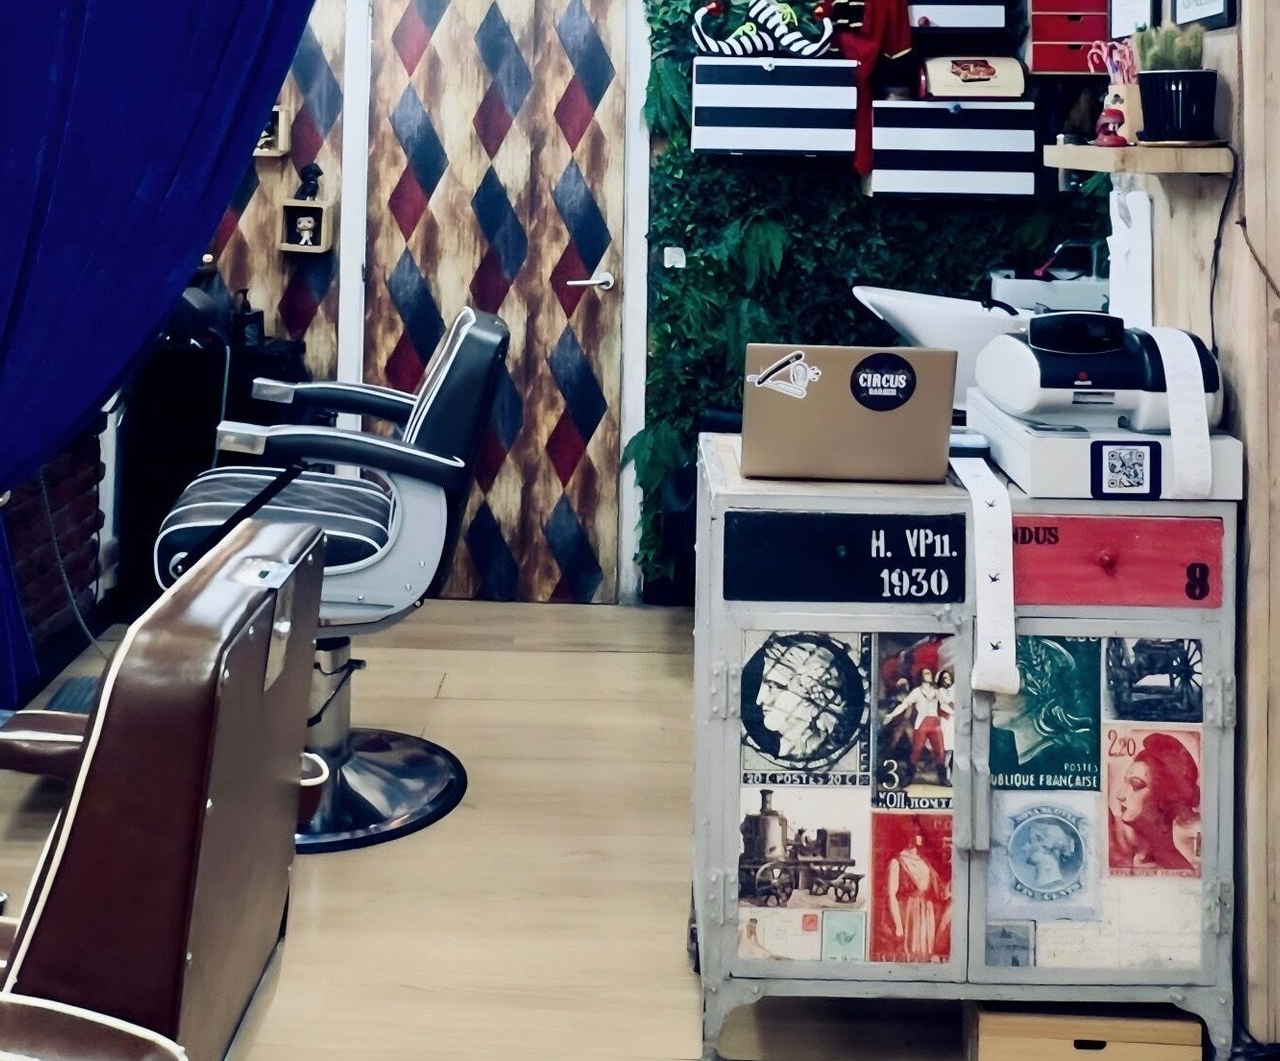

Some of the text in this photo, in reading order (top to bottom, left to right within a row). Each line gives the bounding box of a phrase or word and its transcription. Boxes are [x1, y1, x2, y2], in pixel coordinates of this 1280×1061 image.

[858, 372, 907, 389] CIRCUS
[880, 568, 949, 598] 1930
[1185, 562, 1210, 601] 8
[882, 759, 901, 790] 3
